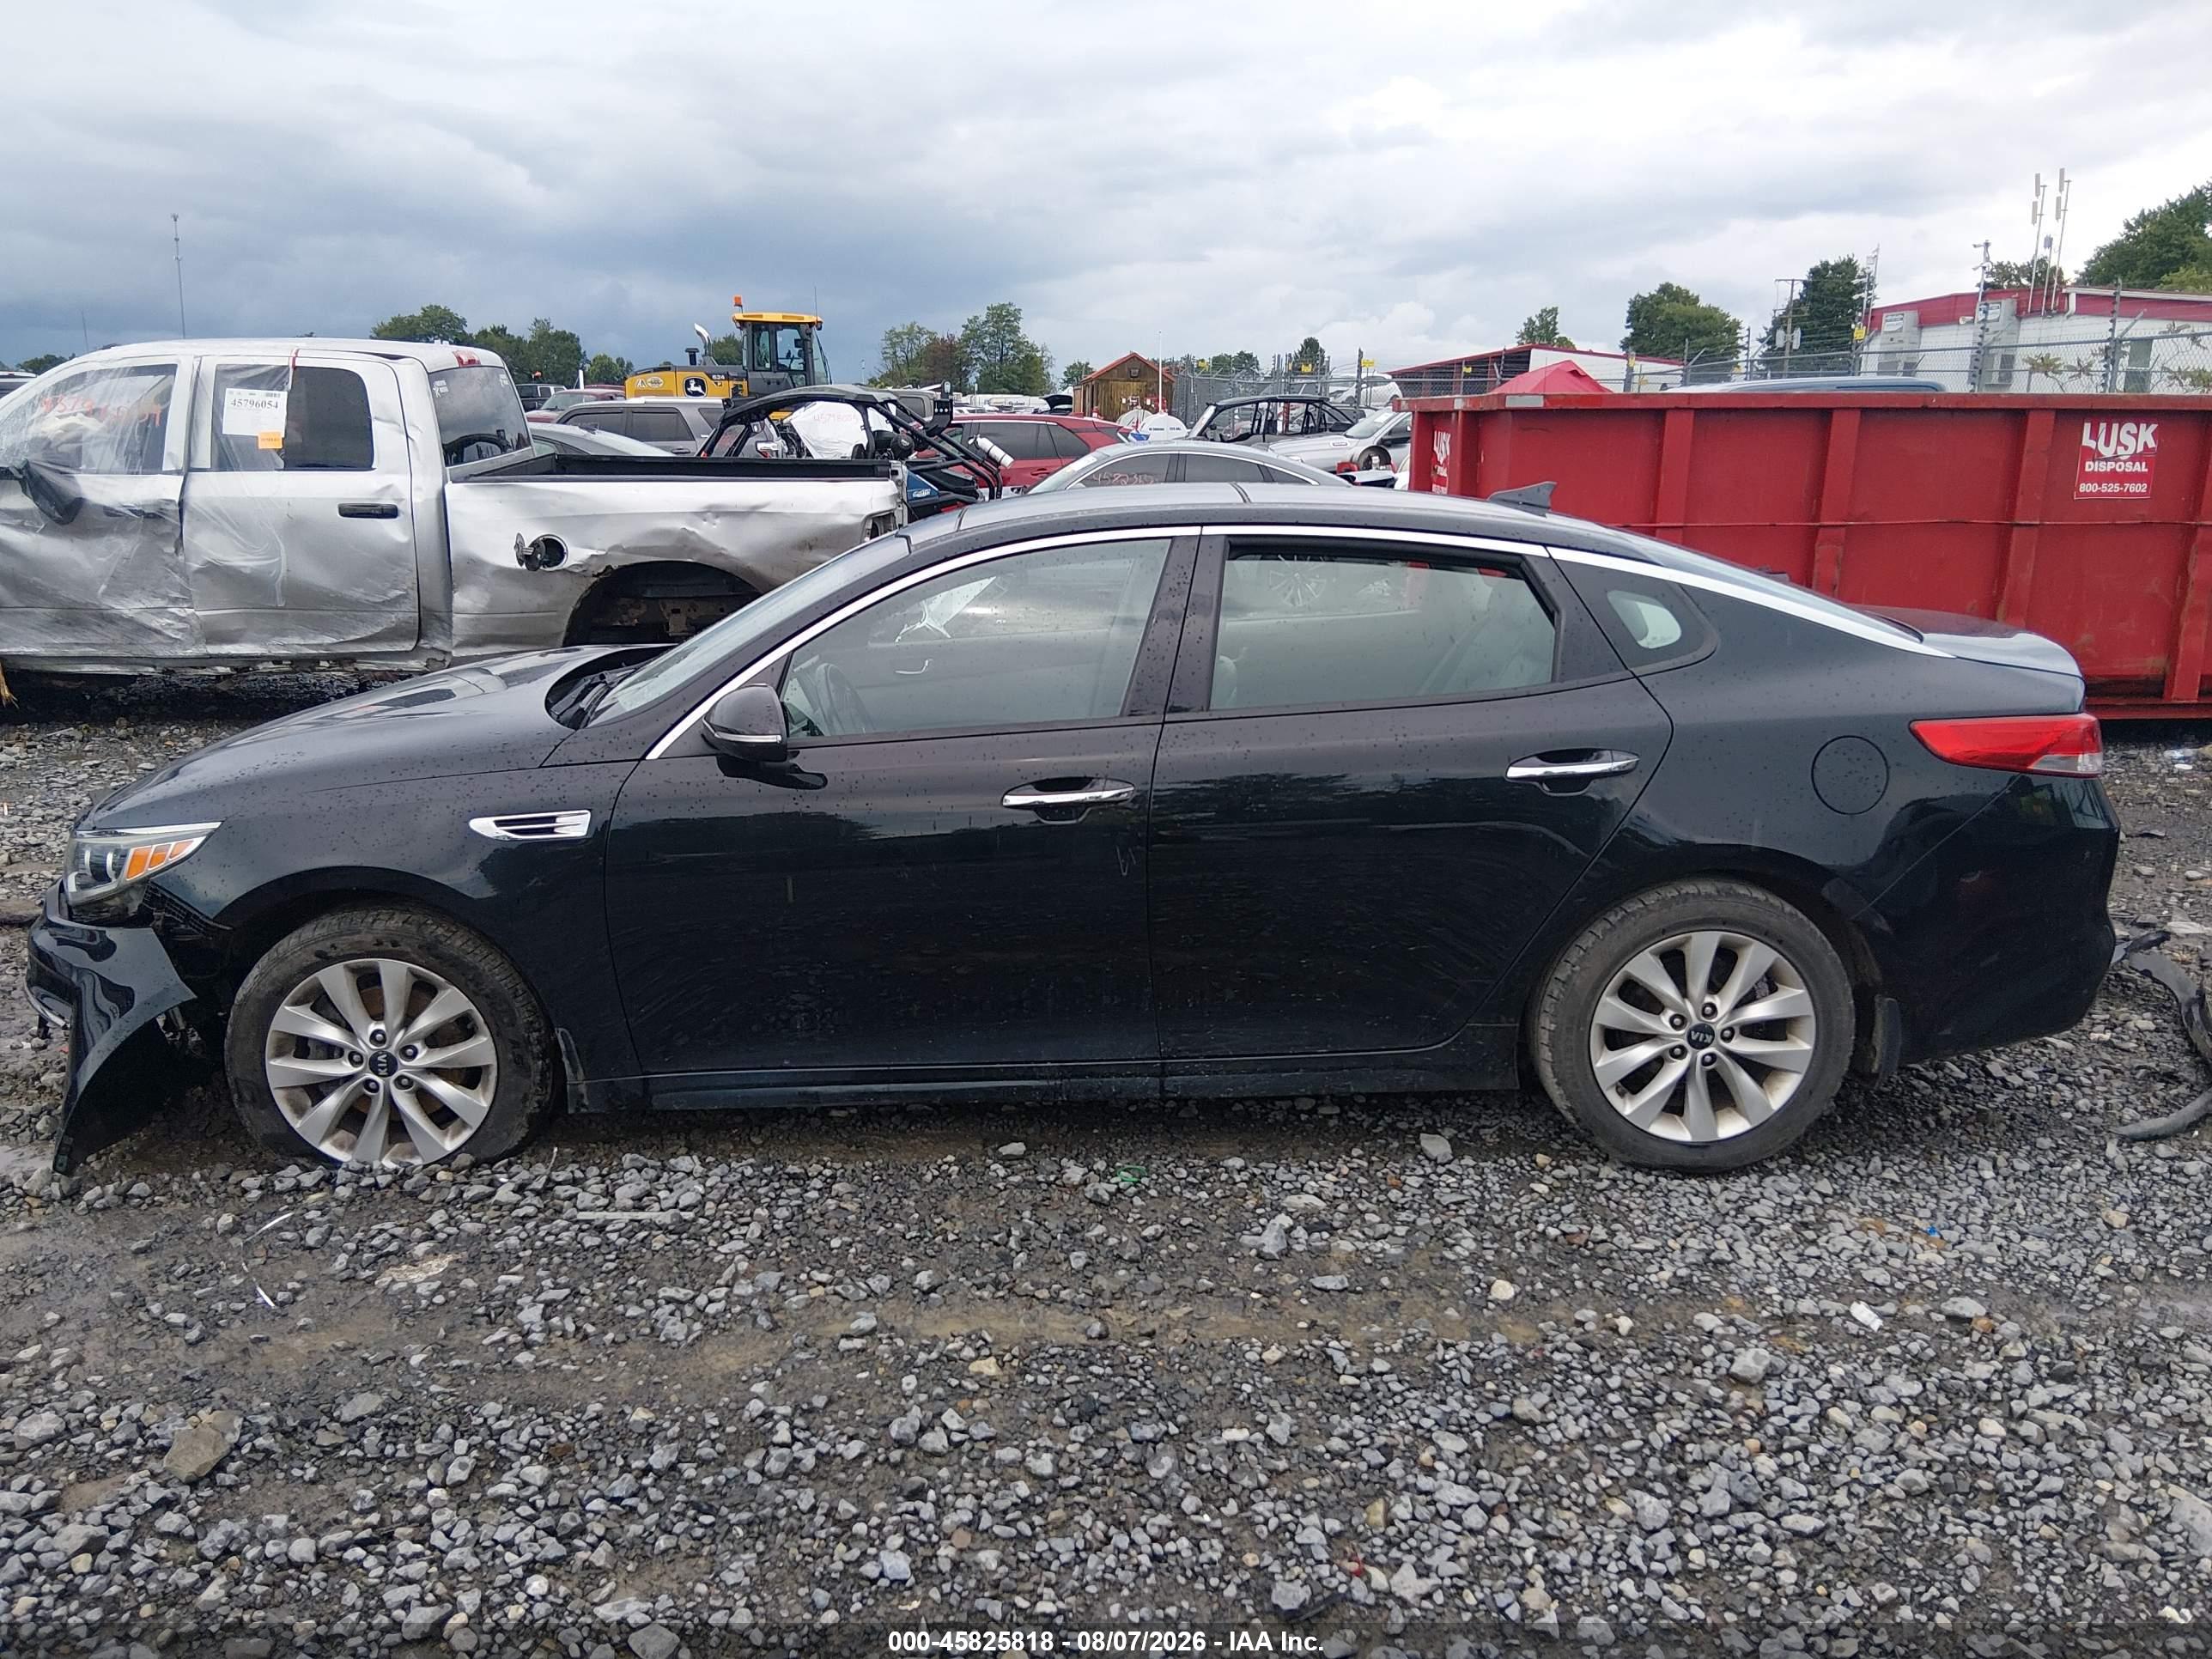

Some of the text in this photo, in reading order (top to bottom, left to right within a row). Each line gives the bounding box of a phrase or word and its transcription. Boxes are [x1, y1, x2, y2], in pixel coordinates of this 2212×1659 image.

[230, 398, 278, 409] 45796054
[2081, 422, 2159, 460] LUSK
[2084, 461, 2148, 472] DISPOSAL
[2079, 483, 2148, 493] 800-525-7602
[1691, 1030, 1713, 1043] KIA
[377, 1054, 388, 1075] KIA
